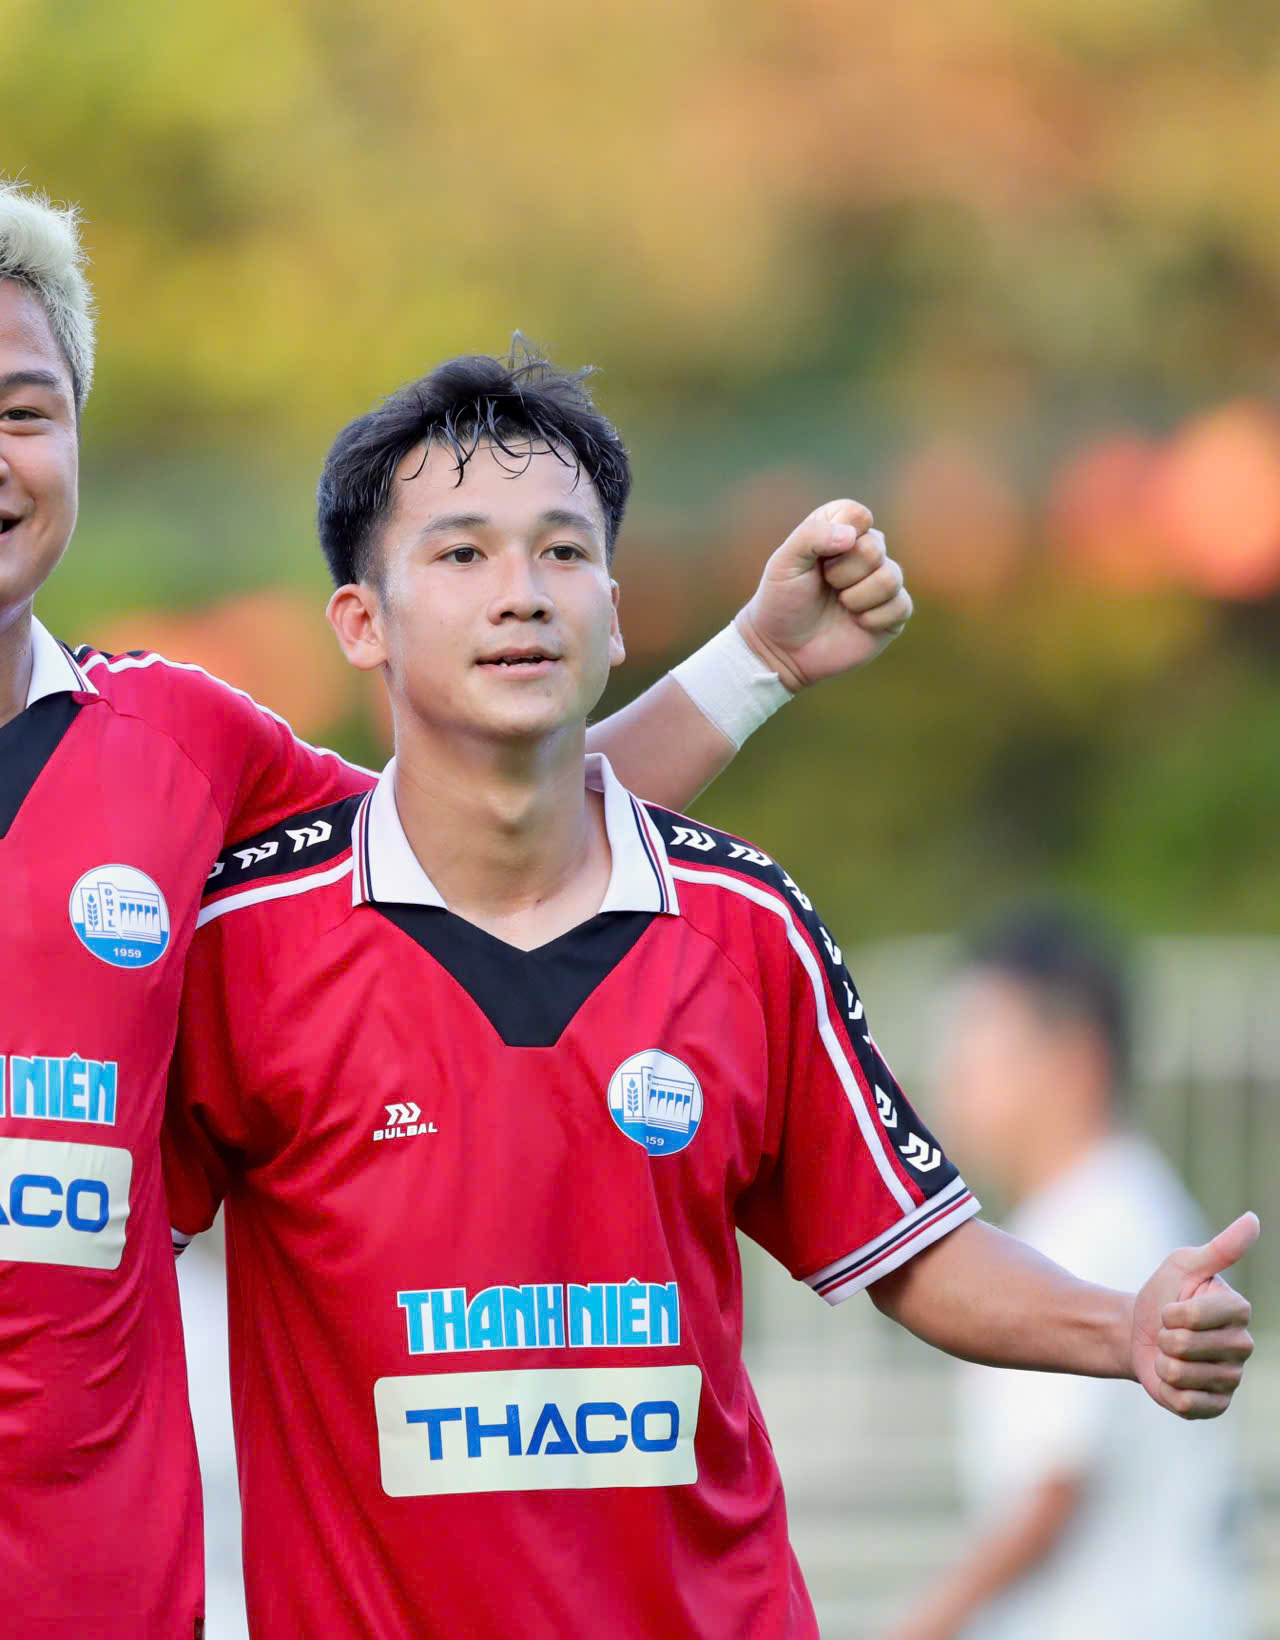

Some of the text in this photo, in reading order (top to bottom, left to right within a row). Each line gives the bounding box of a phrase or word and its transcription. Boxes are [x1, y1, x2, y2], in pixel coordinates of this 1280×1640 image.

[113, 947, 142, 959] 1959
[10, 1052, 118, 1126] NIÊN
[372, 1121, 439, 1142] BULBAL
[396, 1276, 681, 1356] THANH NIÊN
[405, 1400, 680, 1461] THACO
